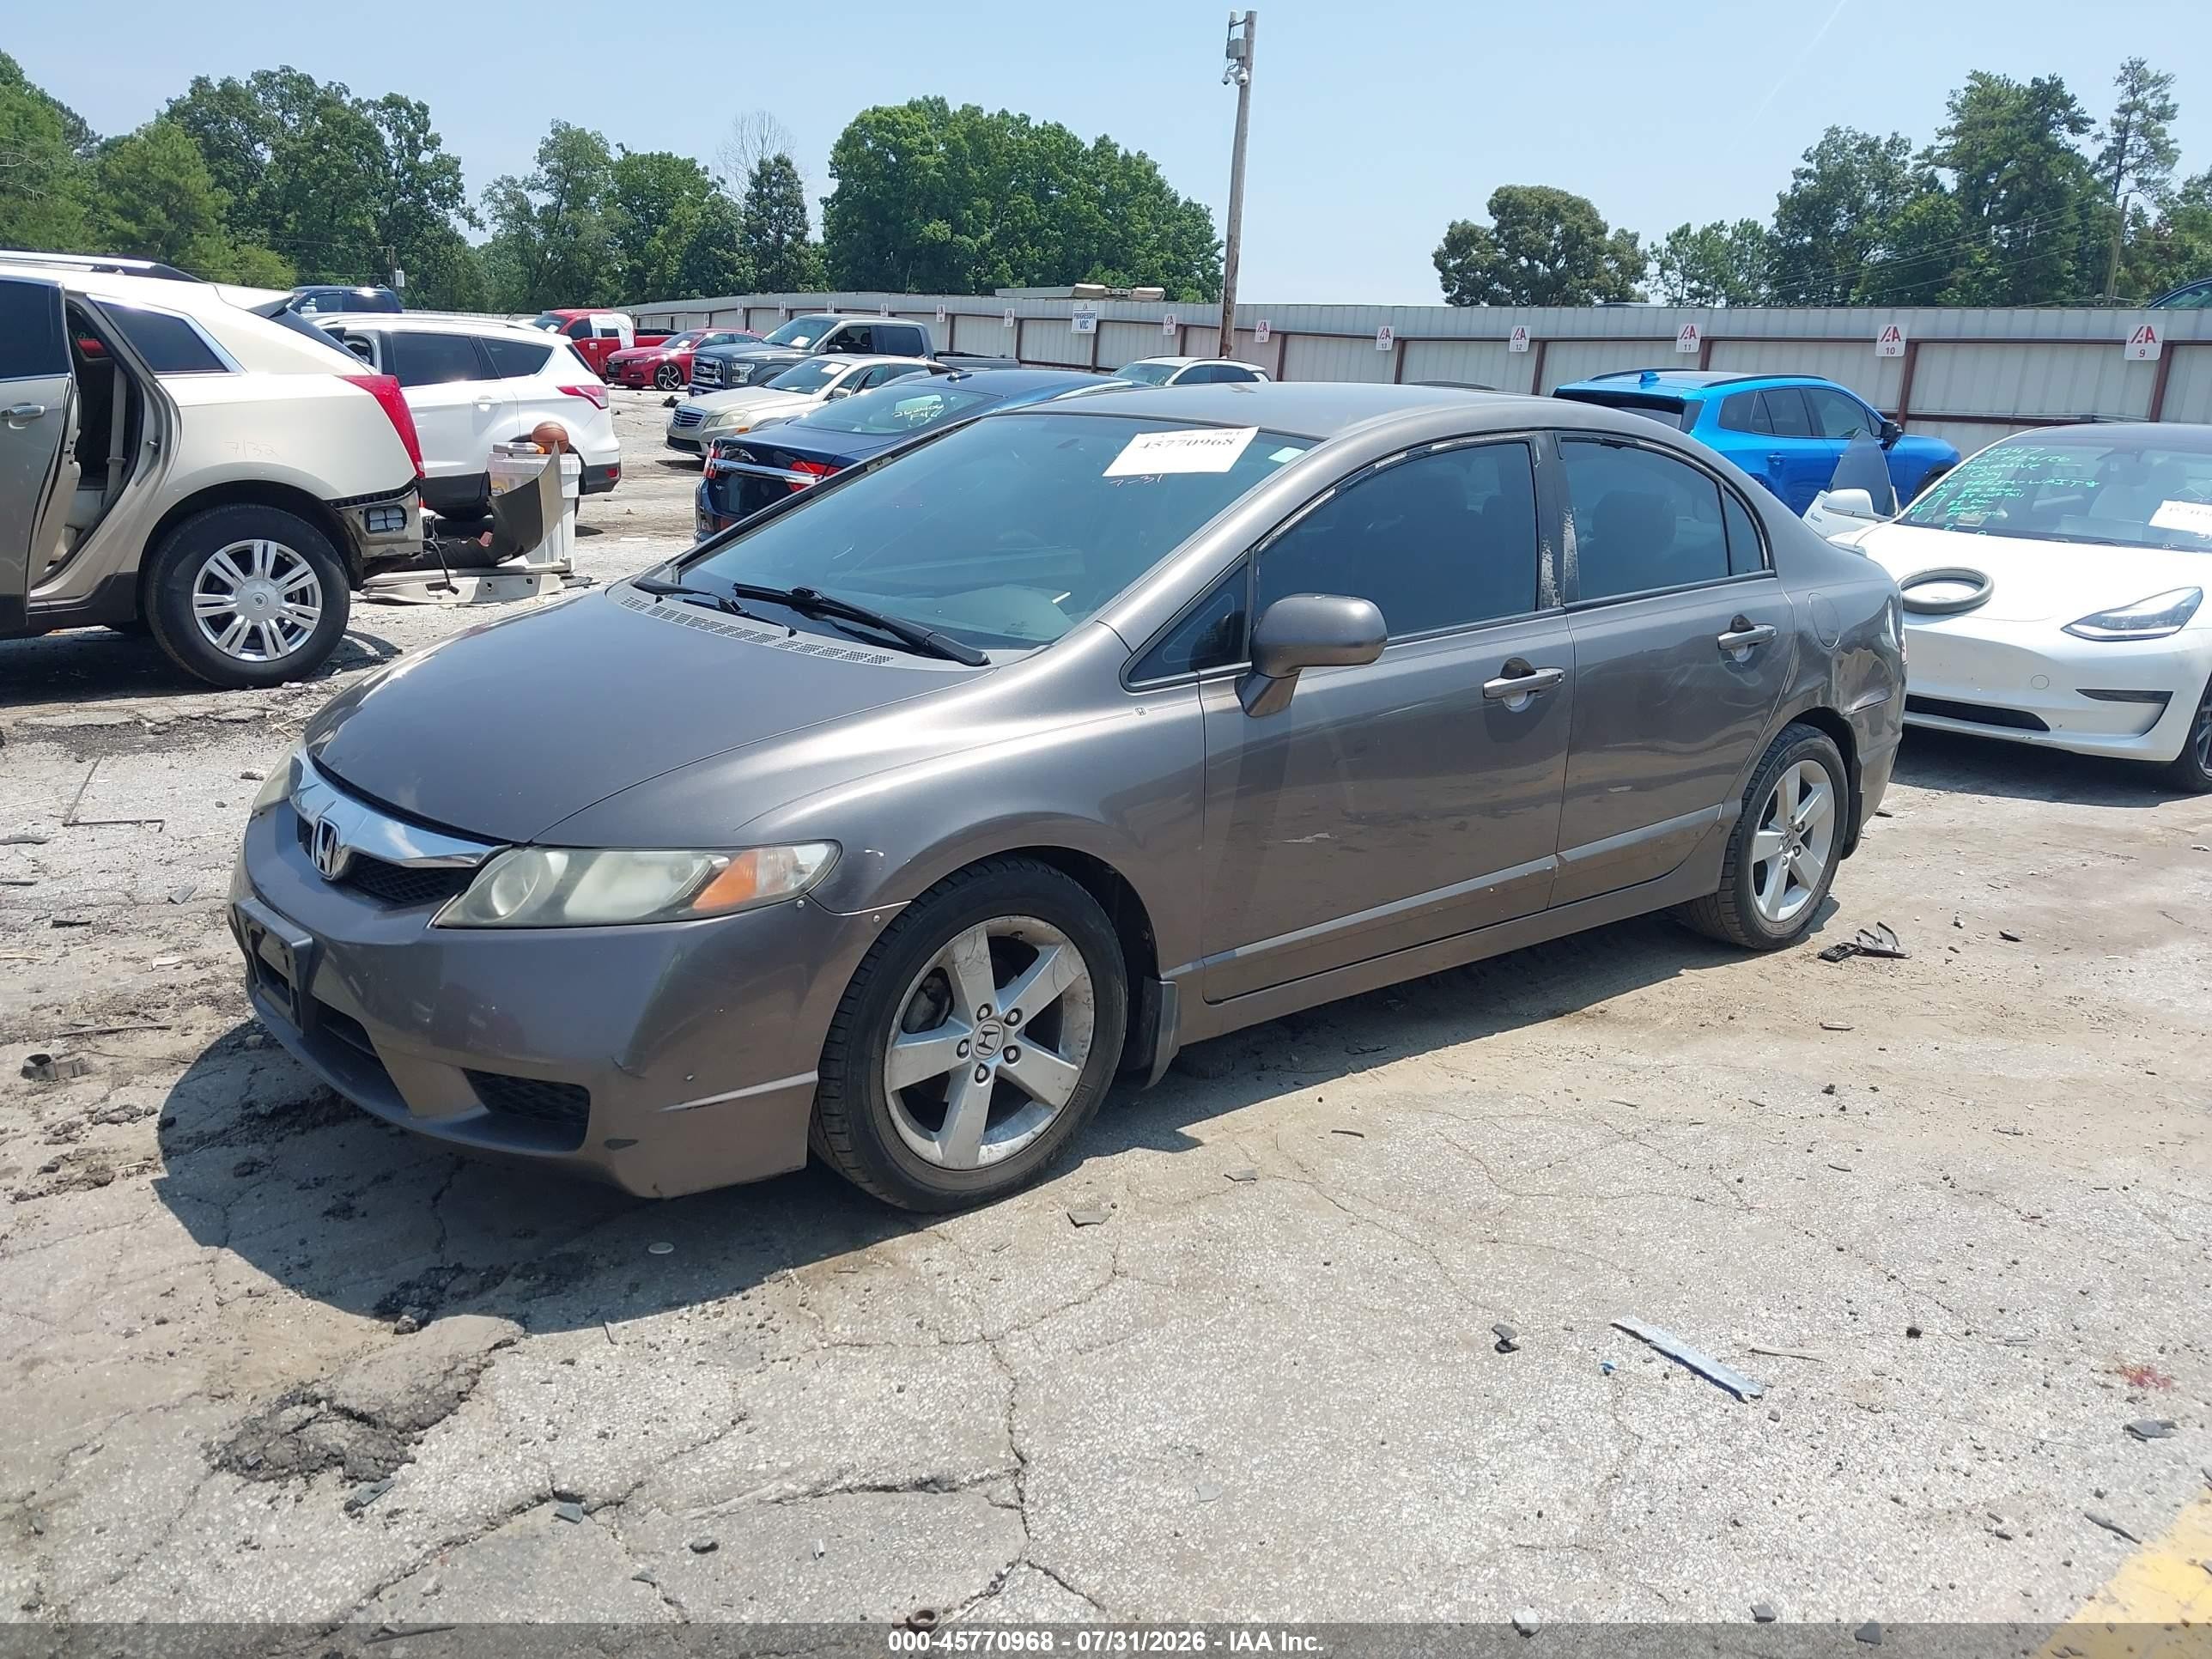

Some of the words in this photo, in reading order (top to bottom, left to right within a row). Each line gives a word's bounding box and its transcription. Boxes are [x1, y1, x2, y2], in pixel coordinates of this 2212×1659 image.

[1079, 319, 1089, 329] VIC
[1886, 346, 1896, 355] 10
[2139, 349, 2146, 357] 9
[1109, 473, 1163, 488] 7-31
